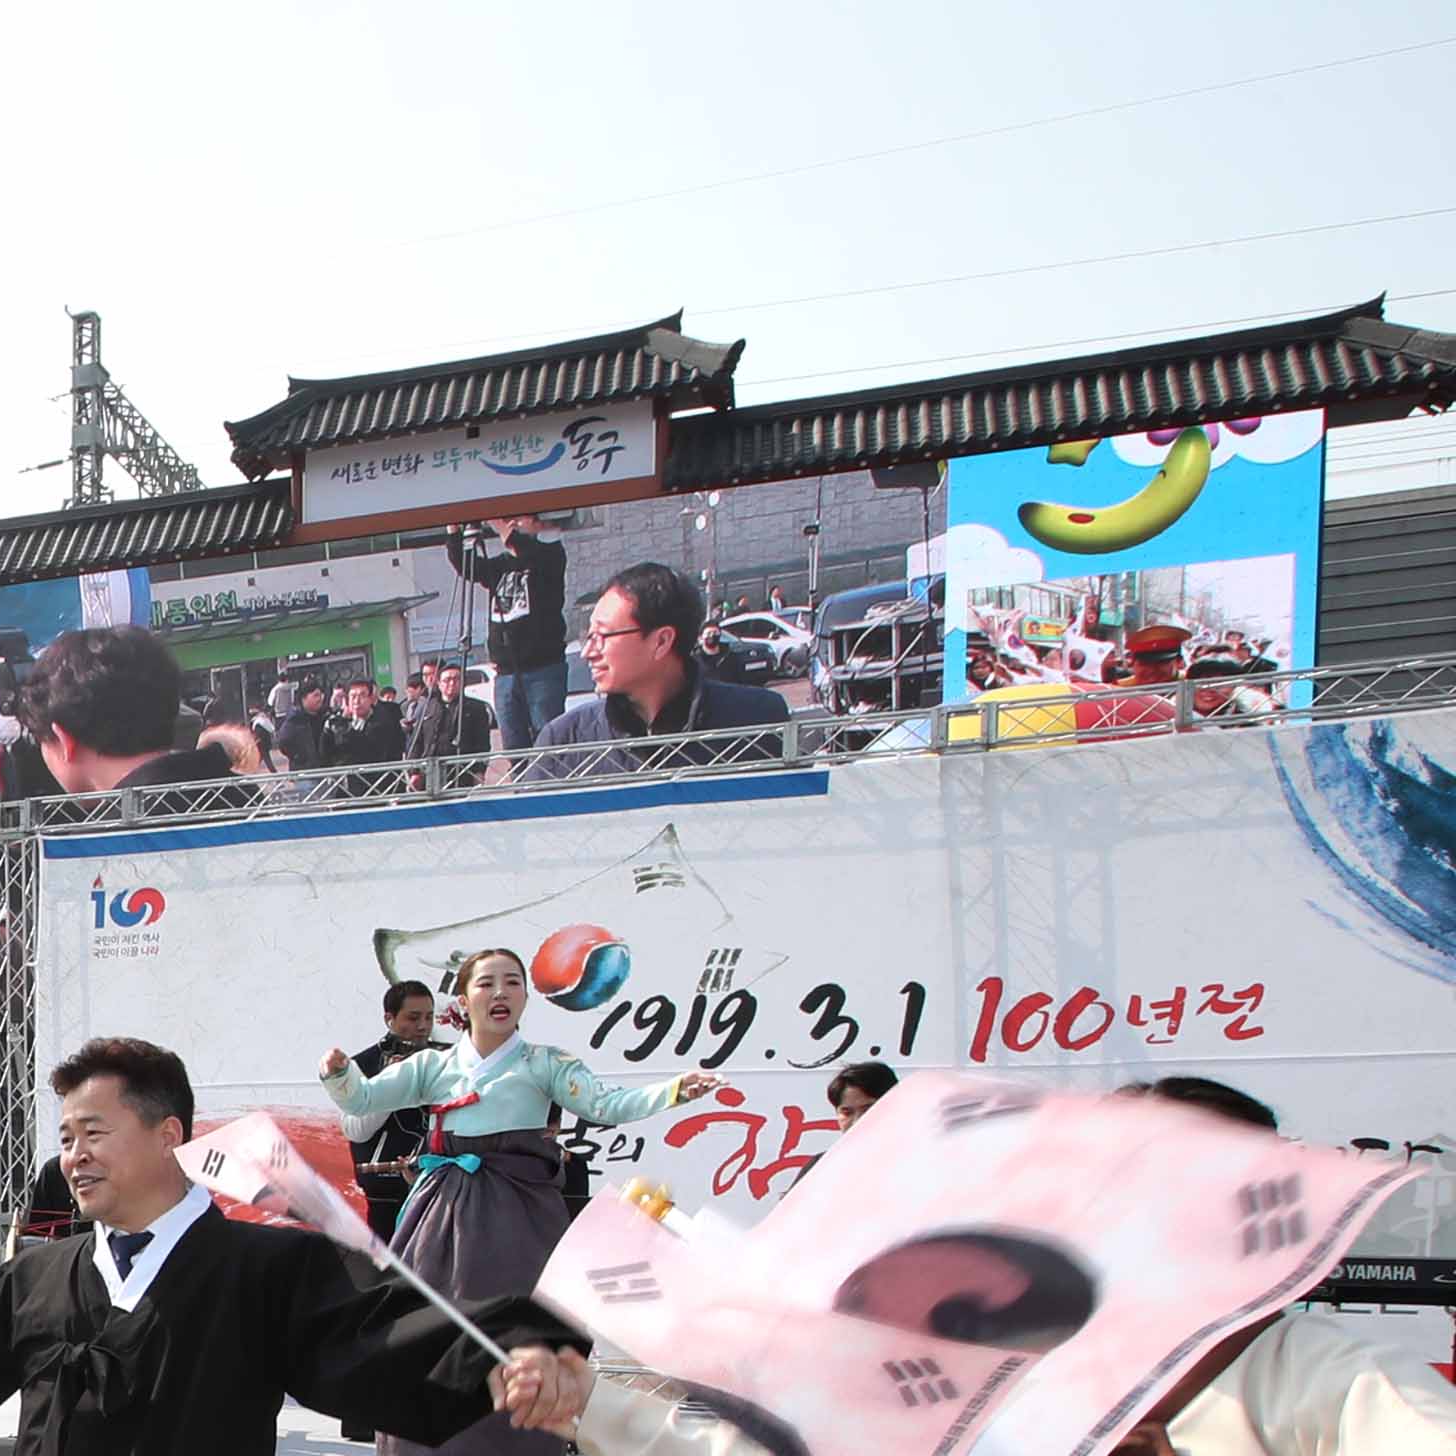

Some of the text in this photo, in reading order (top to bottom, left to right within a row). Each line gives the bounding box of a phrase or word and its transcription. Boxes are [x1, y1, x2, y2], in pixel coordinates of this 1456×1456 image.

[330, 416, 626, 485] 새로운 변화 모두가 행복한 동구
[1346, 1264, 1417, 1281] YAMAHA
